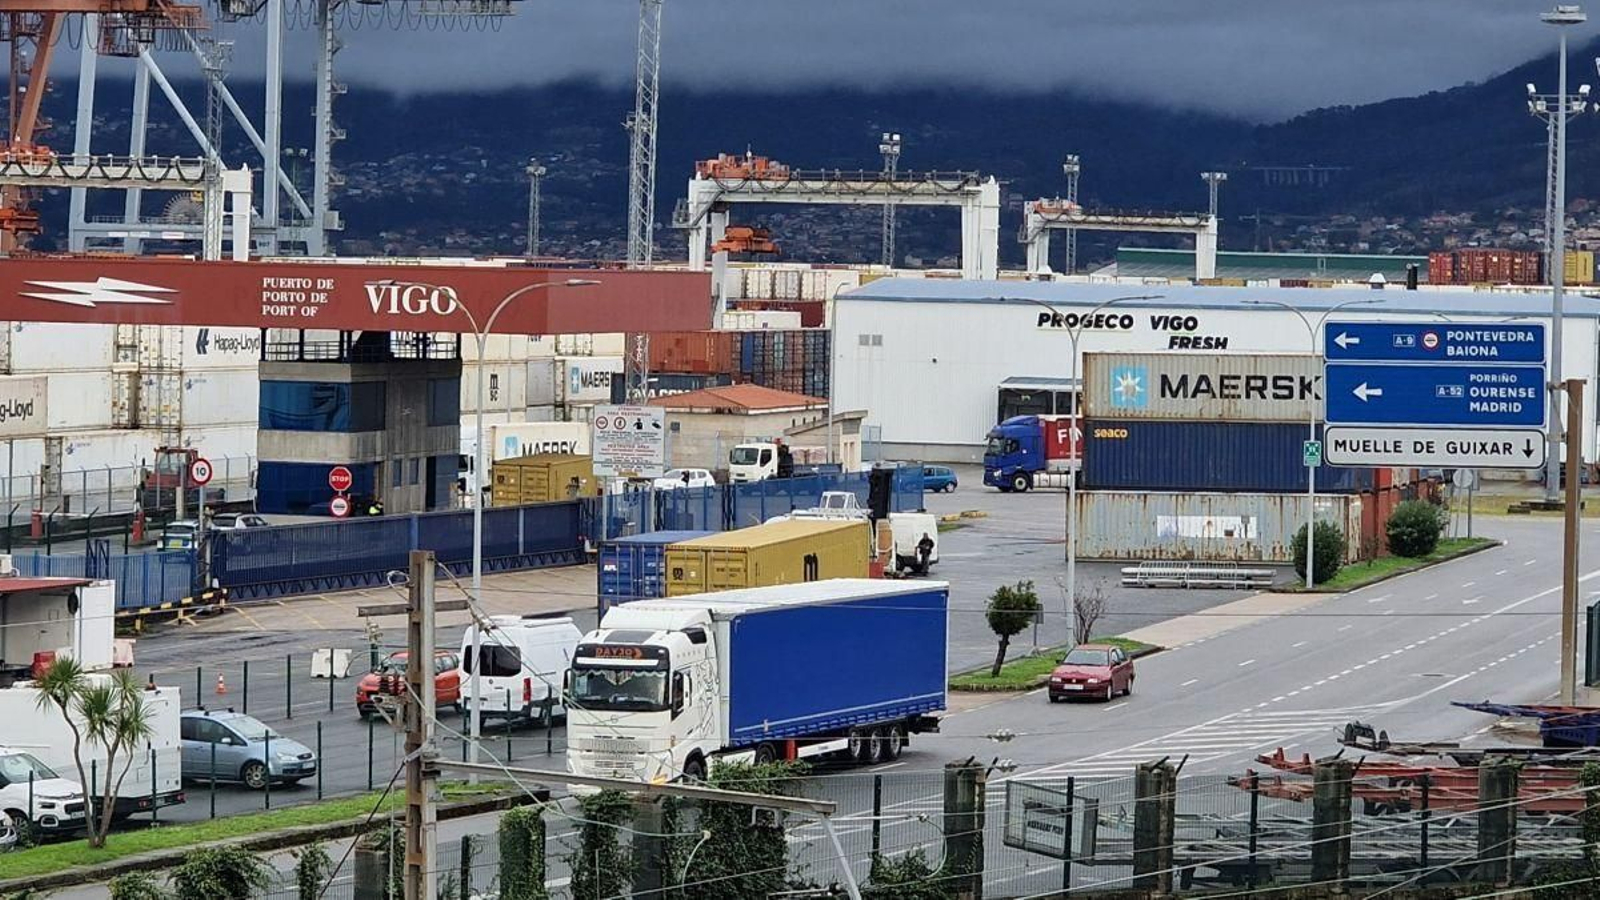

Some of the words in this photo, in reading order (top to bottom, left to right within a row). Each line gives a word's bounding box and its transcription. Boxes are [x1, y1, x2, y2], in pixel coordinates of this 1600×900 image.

[263, 277, 312, 289] PUERTO
[316, 278, 334, 289] DE
[262, 291, 306, 303] PORTO
[310, 292, 328, 303] DE
[365, 284, 457, 315] VIGO
[262, 304, 297, 316] PORT
[300, 306, 319, 317] OF
[1037, 312, 1134, 330] PROGECO
[1150, 315, 1199, 331] VIGO
[1446, 330, 1535, 342] PONTEVEDRA
[213, 333, 260, 355] Hapag-Lloyd
[1168, 335, 1229, 350] FRESH
[1446, 345, 1498, 356] BAIONA
[581, 370, 617, 389] MAERS
[1469, 372, 1518, 383] PORRIÑO
[1160, 373, 1322, 401] MAERSK
[1438, 386, 1463, 396] A-52
[1469, 386, 1536, 398] OURENSE
[1469, 402, 1522, 413] MADRID
[1094, 428, 1128, 438] seaco
[1334, 439, 1403, 453] MUELLE
[1413, 440, 1436, 454] DE
[1445, 441, 1513, 456] GUIXAR
[195, 467, 206, 477] 10
[331, 475, 349, 483] STOP
